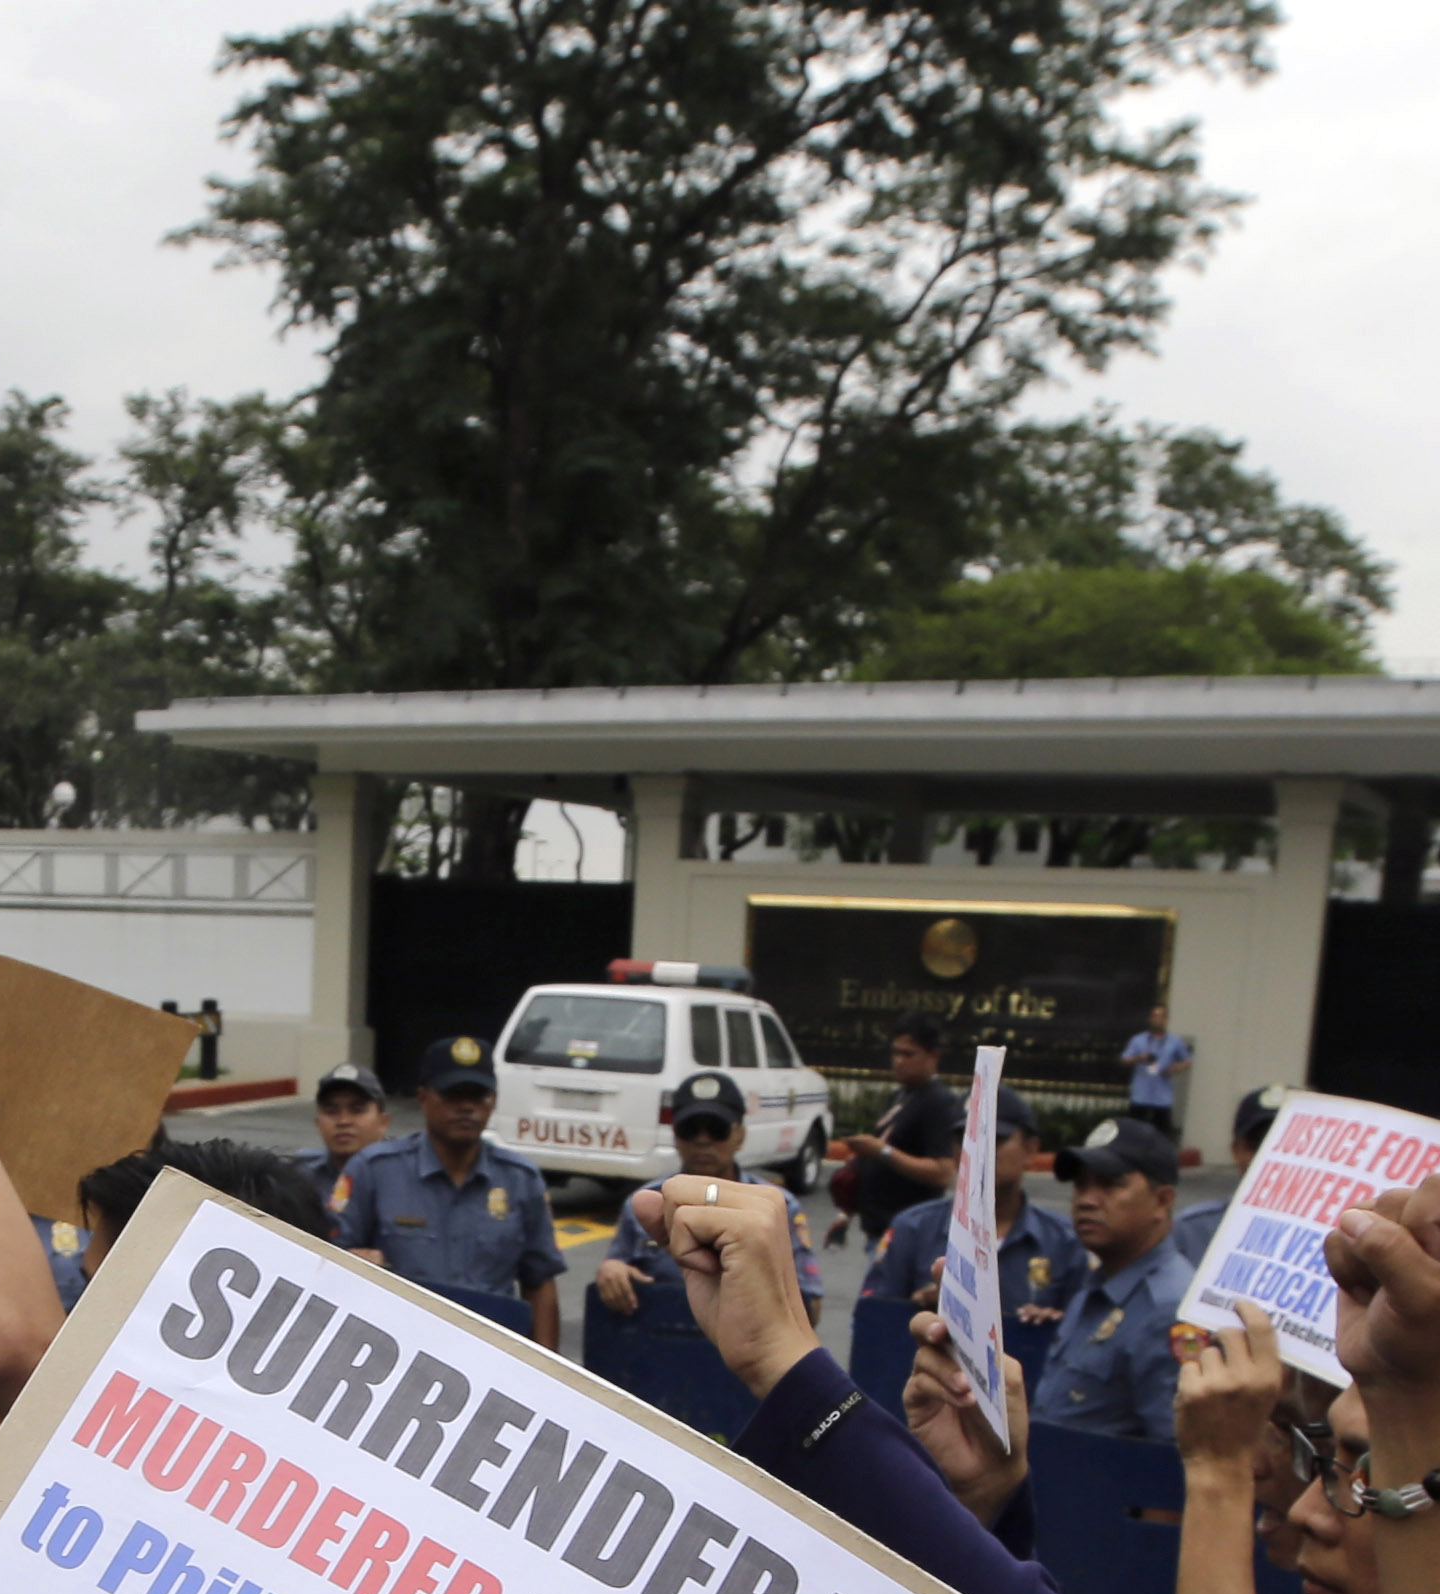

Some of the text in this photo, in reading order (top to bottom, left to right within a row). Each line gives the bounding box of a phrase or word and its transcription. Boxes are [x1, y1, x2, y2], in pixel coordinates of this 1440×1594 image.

[840, 979, 1056, 1019] Embassy of the
[517, 1117, 629, 1150] PULISYA
[1272, 1112, 1379, 1168] JUSTICE
[1236, 1215, 1289, 1257] JUNK
[1251, 1261, 1338, 1321] EDCA!
[21, 1482, 104, 1570] to
